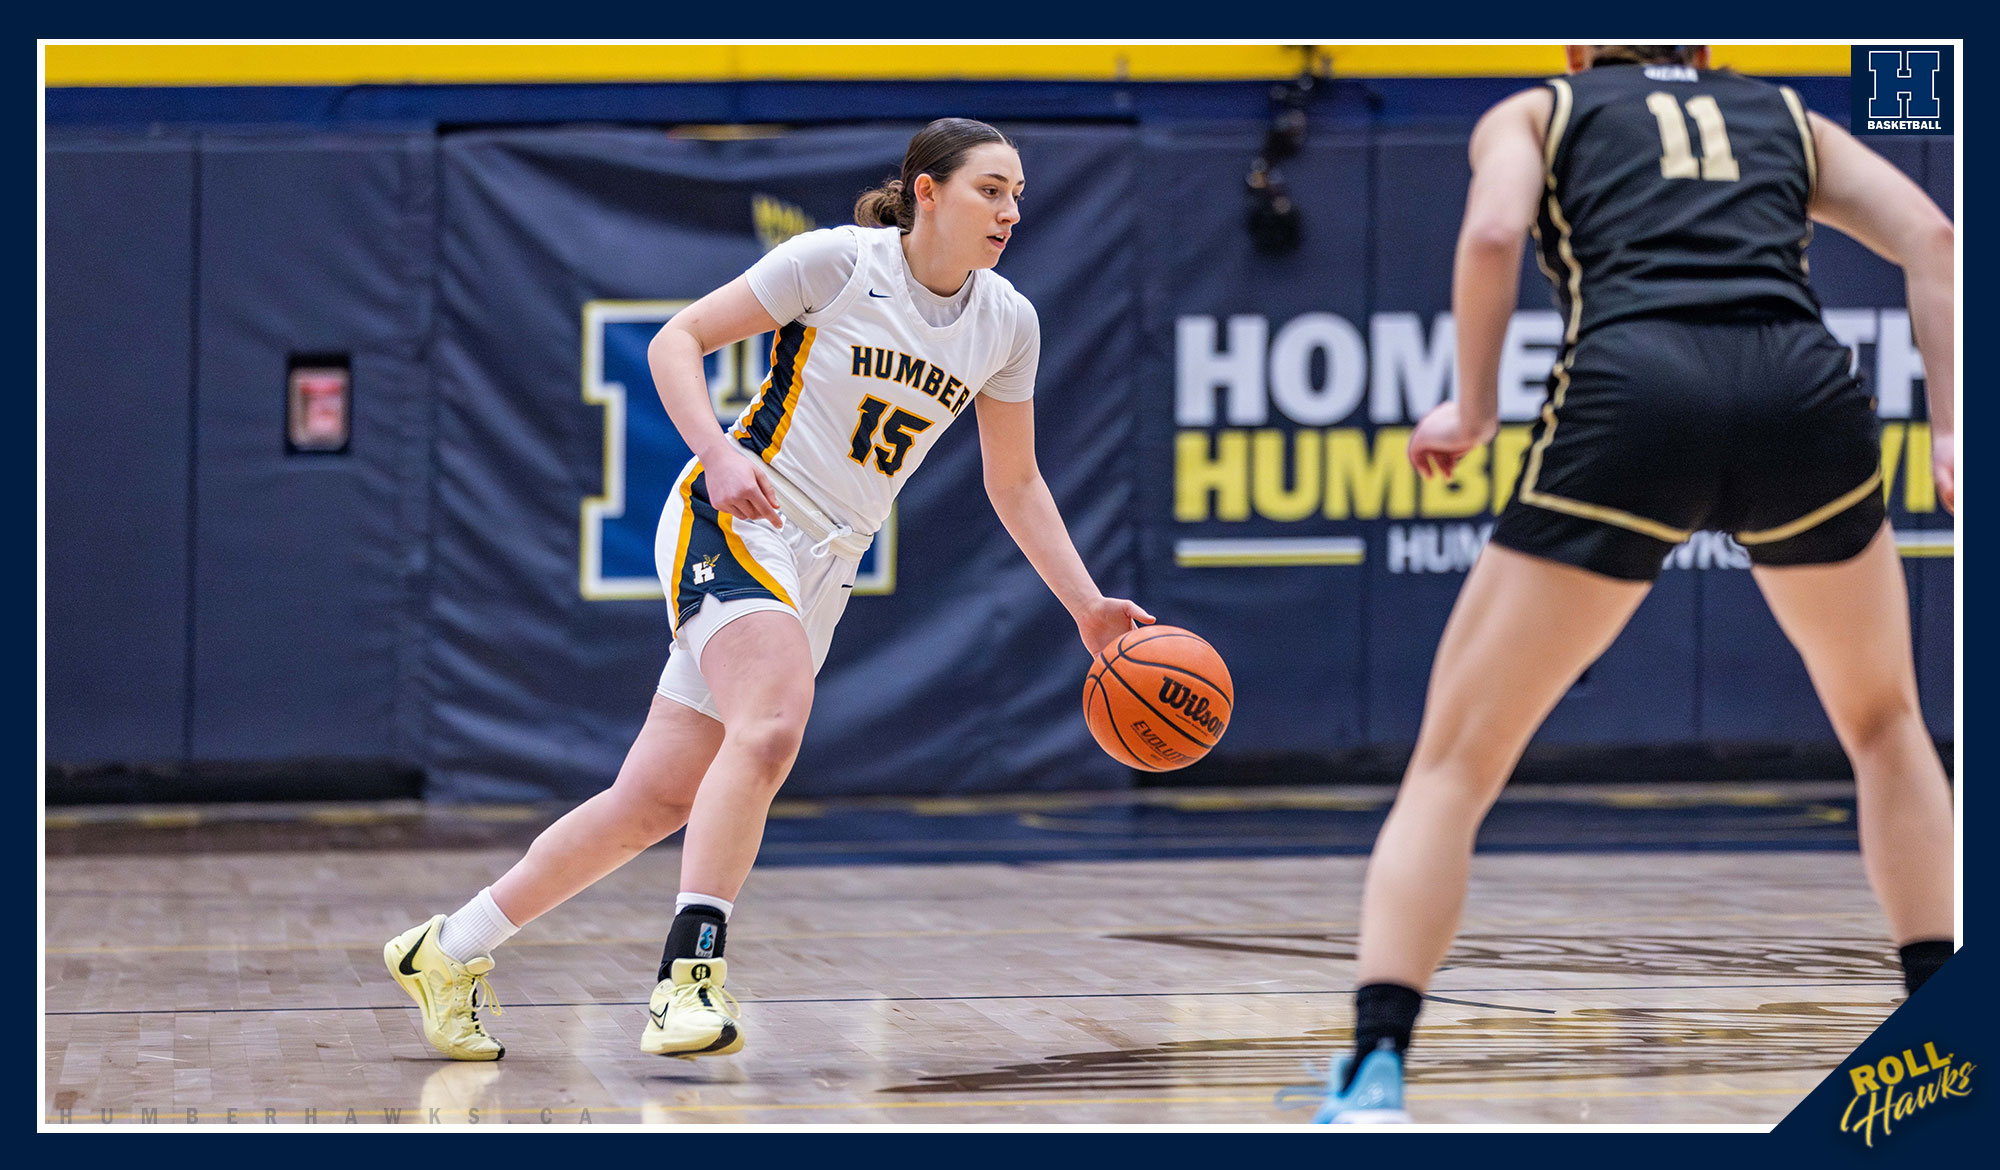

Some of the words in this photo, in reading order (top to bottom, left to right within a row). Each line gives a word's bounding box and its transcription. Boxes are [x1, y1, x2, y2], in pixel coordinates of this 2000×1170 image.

[1646, 91, 1740, 181] 11
[850, 345, 971, 418] HUMBER
[847, 393, 936, 478] 15
[1158, 676, 1225, 739] Wilson
